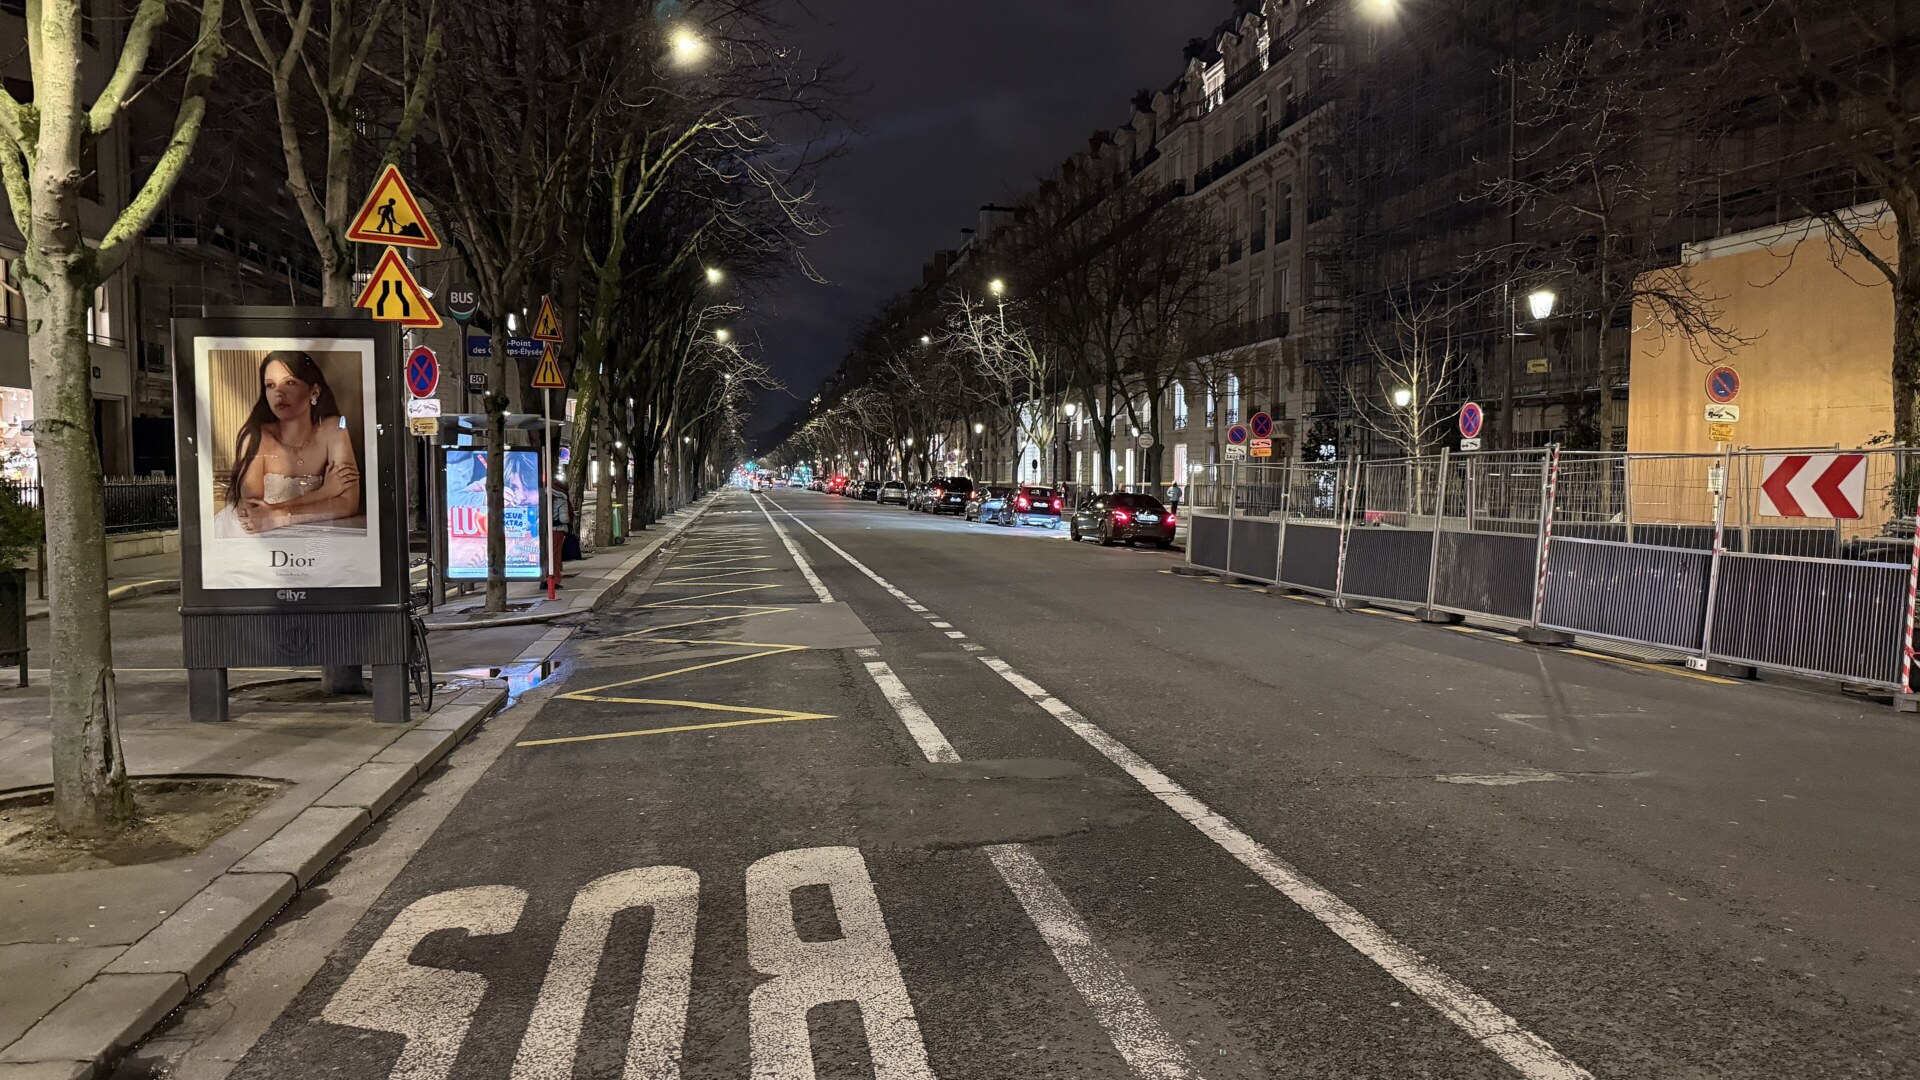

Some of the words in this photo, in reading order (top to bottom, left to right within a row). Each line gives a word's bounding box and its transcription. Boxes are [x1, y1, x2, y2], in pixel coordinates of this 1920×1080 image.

[450, 292, 474, 304] BUS
[473, 346, 486, 354] des
[471, 375, 483, 383] 80
[452, 507, 478, 534] LU
[503, 520, 523, 528] XTRA
[268, 550, 316, 568] Dior
[276, 589, 307, 602] Cityz
